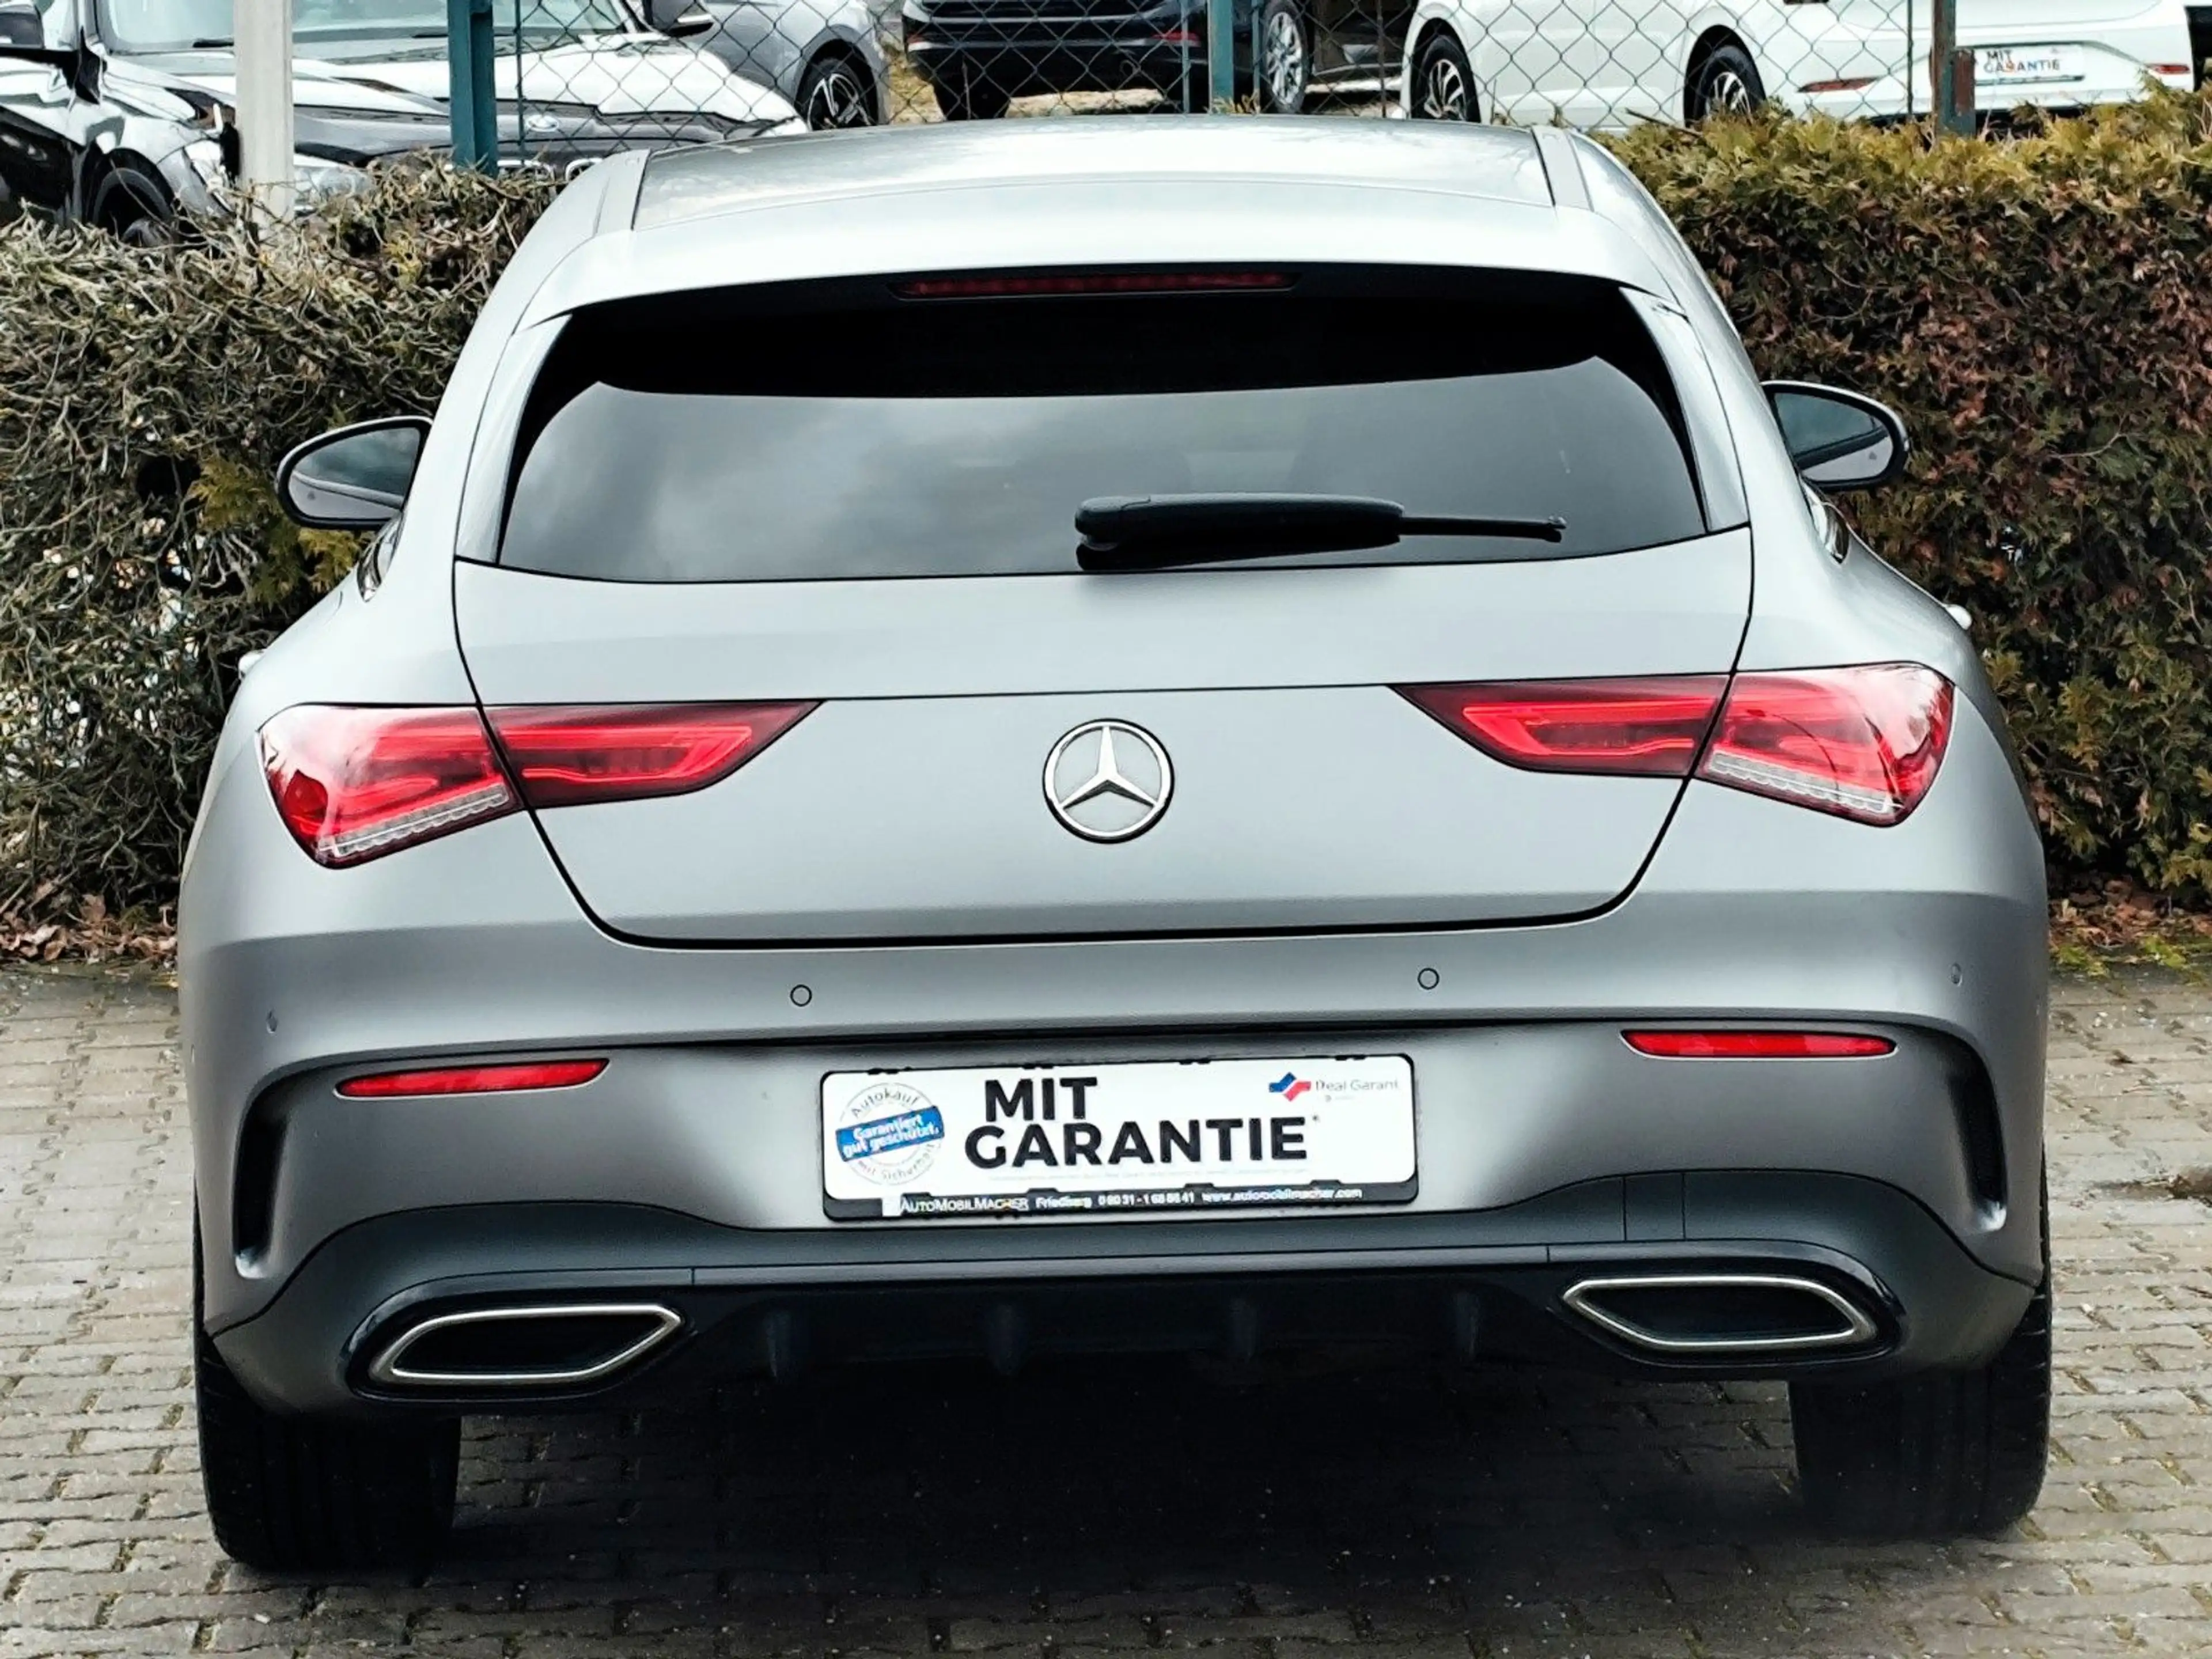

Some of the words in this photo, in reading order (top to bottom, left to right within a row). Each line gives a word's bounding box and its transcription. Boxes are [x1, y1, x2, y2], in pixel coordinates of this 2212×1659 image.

[1987, 50, 2012, 61] MIT
[851, 1088, 921, 1118] Autokauf
[985, 1077, 1097, 1122] MIT
[853, 1114, 924, 1139] Garantiert
